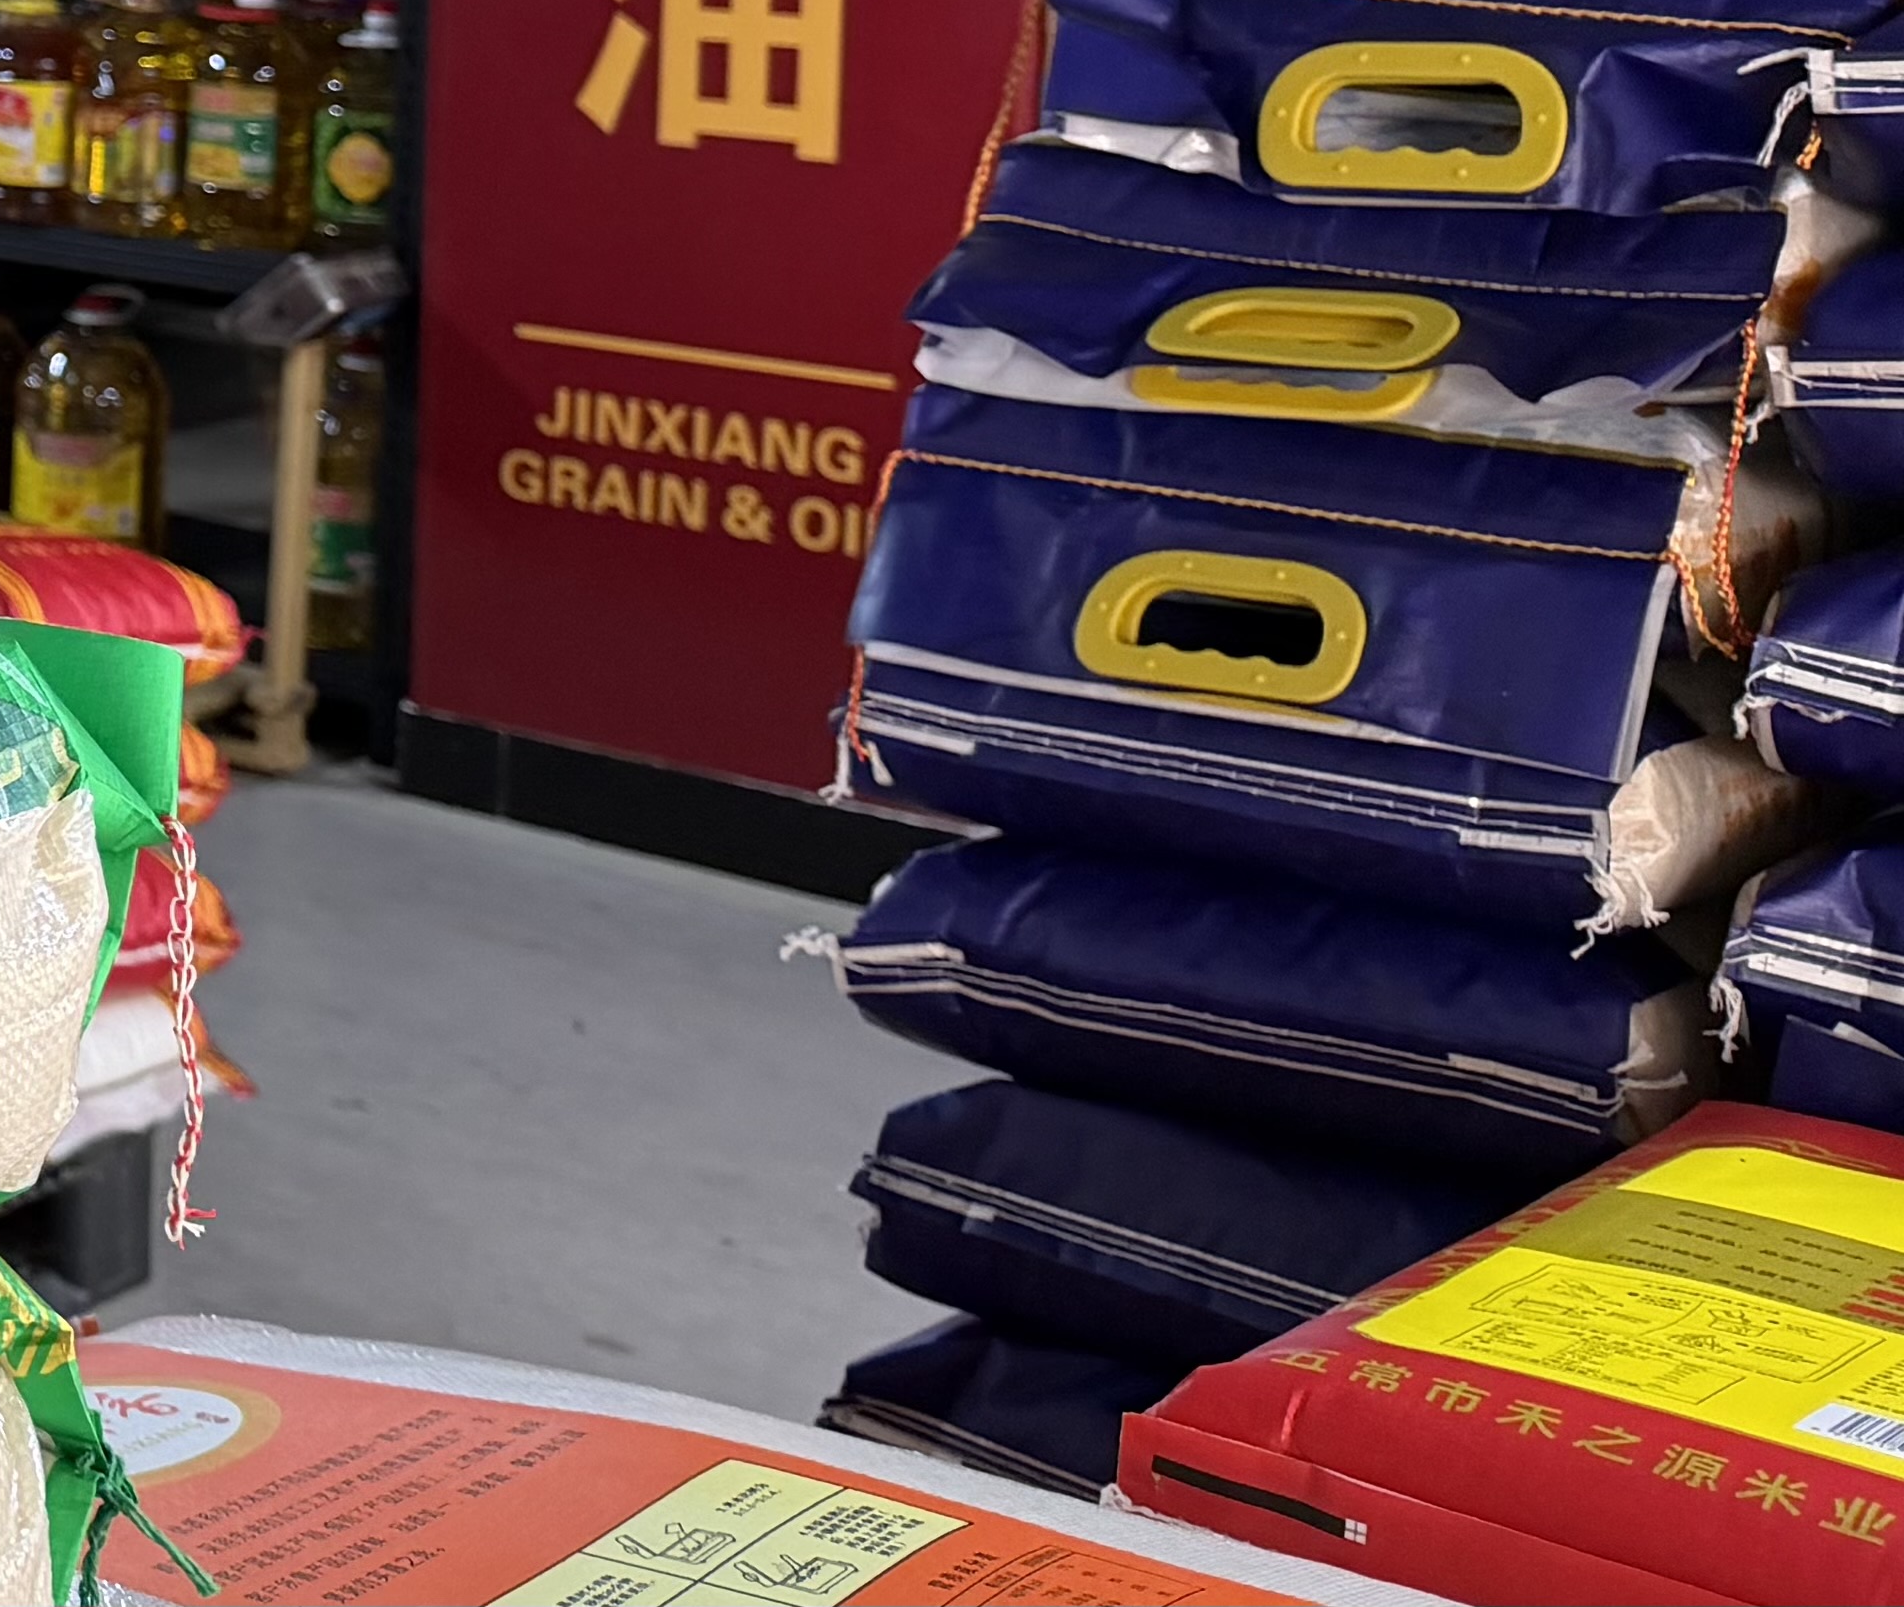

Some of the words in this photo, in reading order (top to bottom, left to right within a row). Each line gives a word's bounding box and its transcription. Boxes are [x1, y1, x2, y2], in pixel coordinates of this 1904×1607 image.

[534, 385, 866, 485] JINXIANG
[498, 447, 709, 533] GRAIN
[720, 484, 775, 545] &
[788, 494, 864, 560] OI
[1271, 1347, 1898, 1548] 五常市禾之源米业
